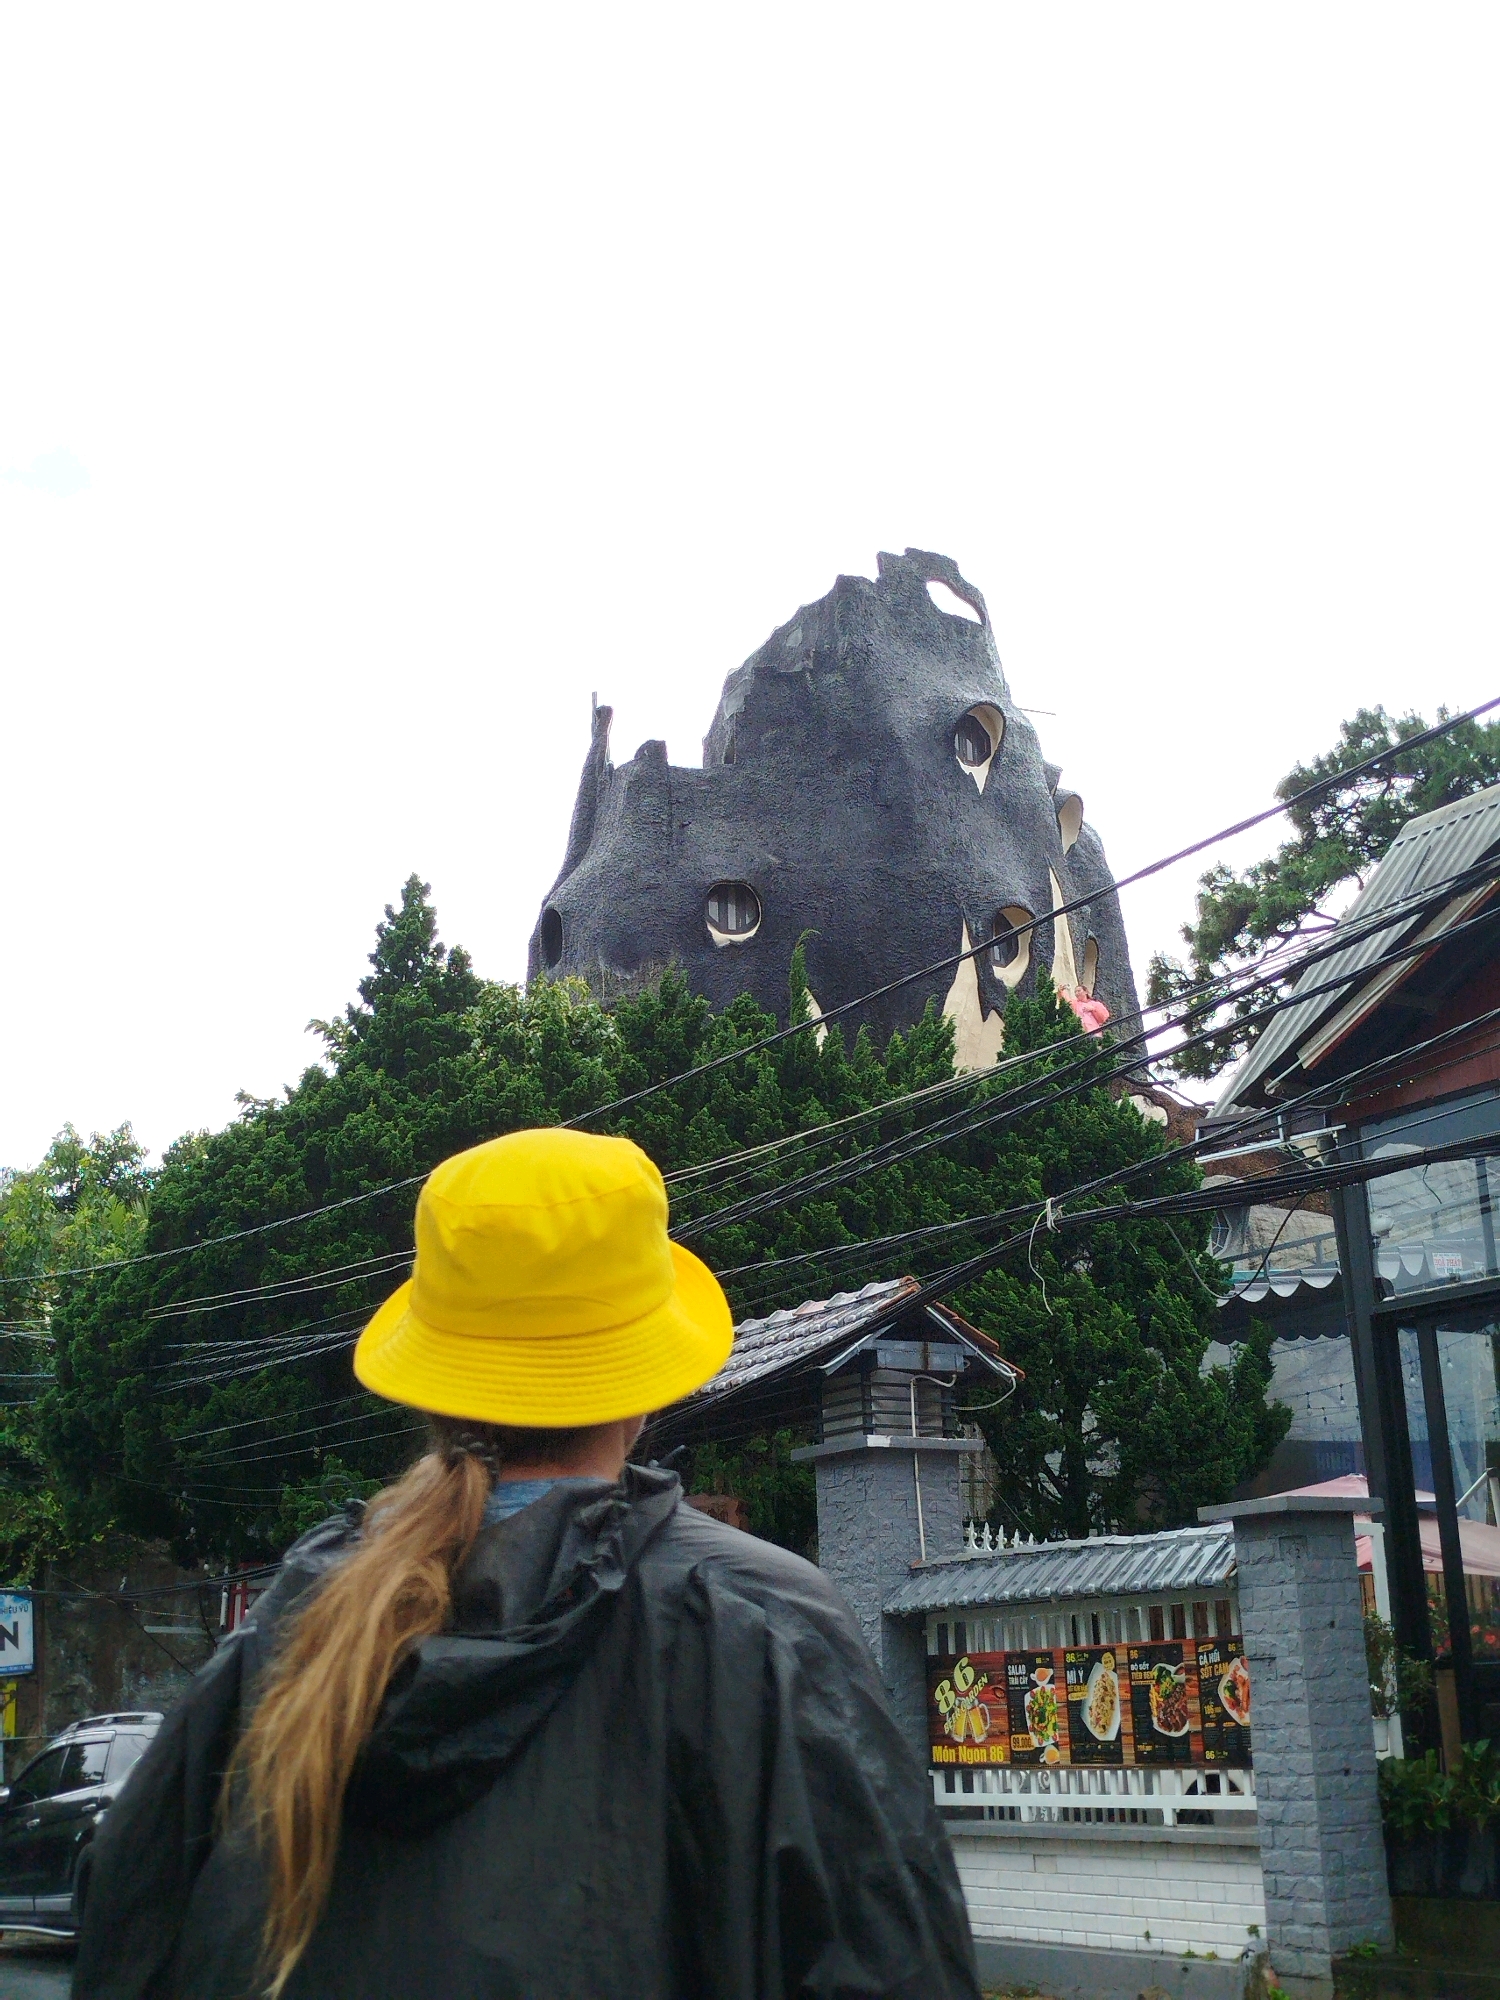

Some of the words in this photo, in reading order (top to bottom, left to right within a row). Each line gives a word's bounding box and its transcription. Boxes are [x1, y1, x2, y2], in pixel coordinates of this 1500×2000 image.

[1008, 1664, 1026, 1675] SALAD
[935, 1657, 974, 1713] 86
[932, 1745, 956, 1763] Món
[958, 1745, 987, 1764] Ngon
[990, 1746, 1004, 1762] 86
[1205, 1750, 1215, 1760] 86
